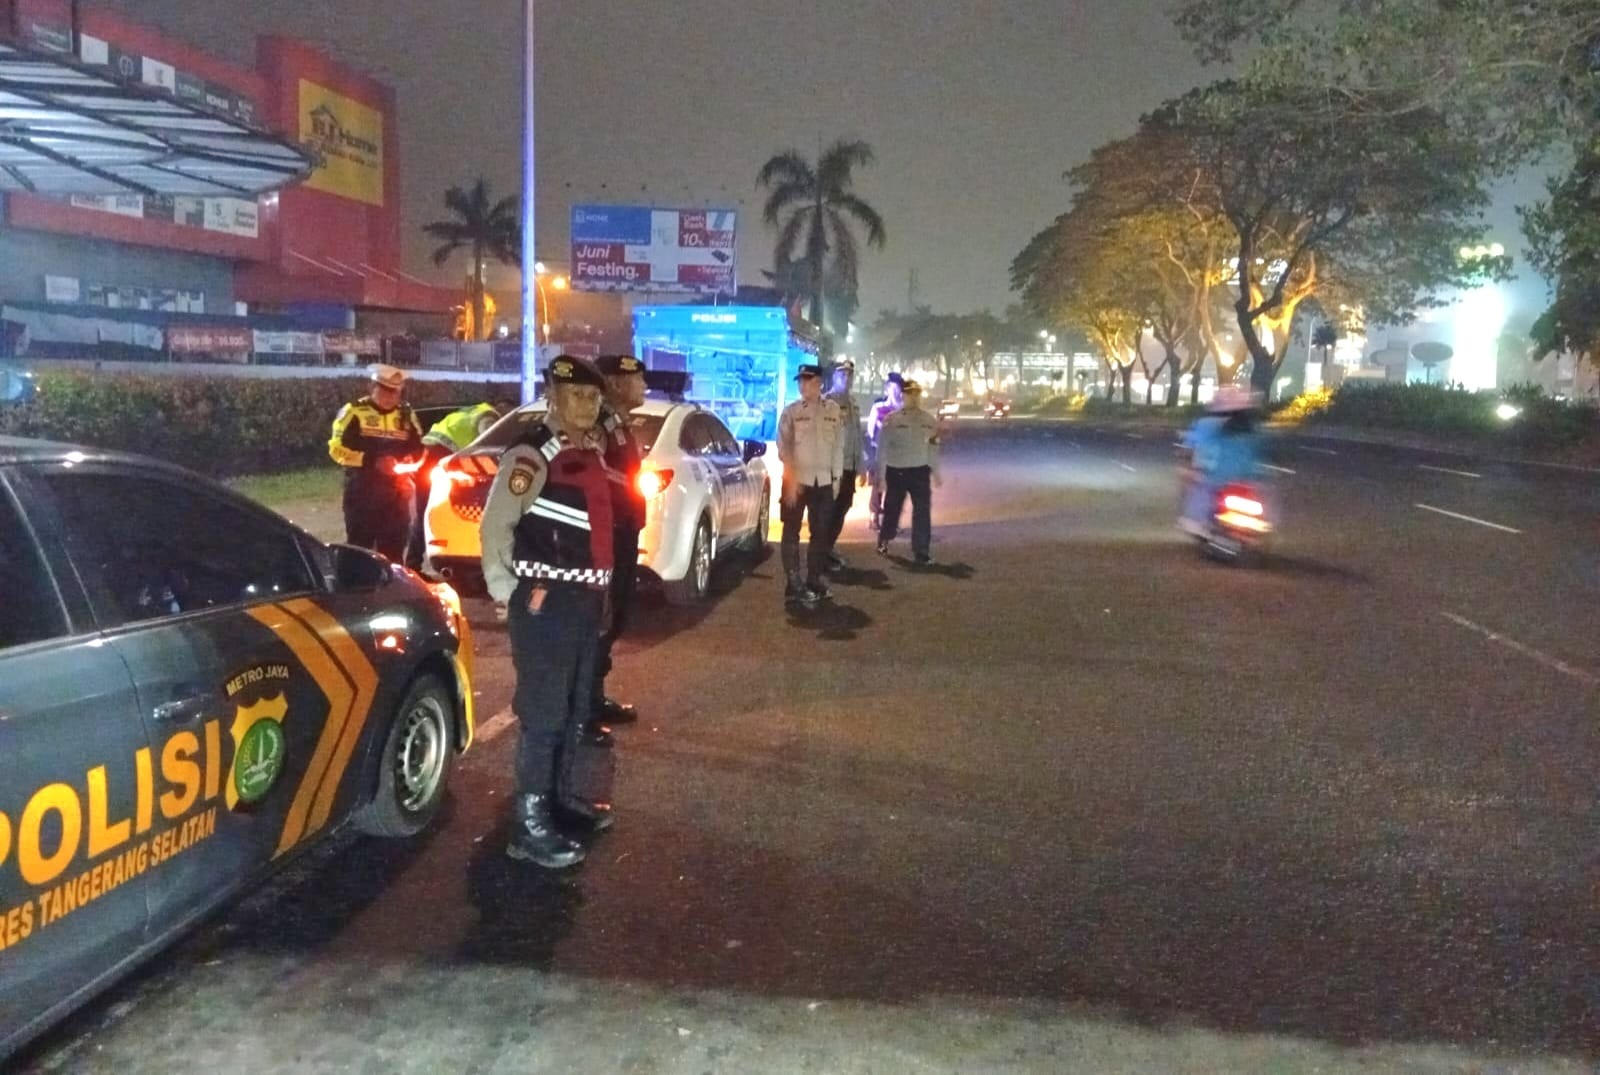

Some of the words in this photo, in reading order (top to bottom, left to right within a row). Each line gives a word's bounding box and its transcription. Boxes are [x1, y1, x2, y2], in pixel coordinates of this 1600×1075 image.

[576, 244, 611, 259] Juni
[577, 262, 640, 280] Festing.
[691, 313, 737, 323] POLISI
[226, 666, 264, 696] METRO
[265, 665, 290, 679] JAYA
[0, 719, 220, 885] OLISI
[39, 842, 148, 927] TANGERANG
[150, 807, 217, 866] SELATAN
